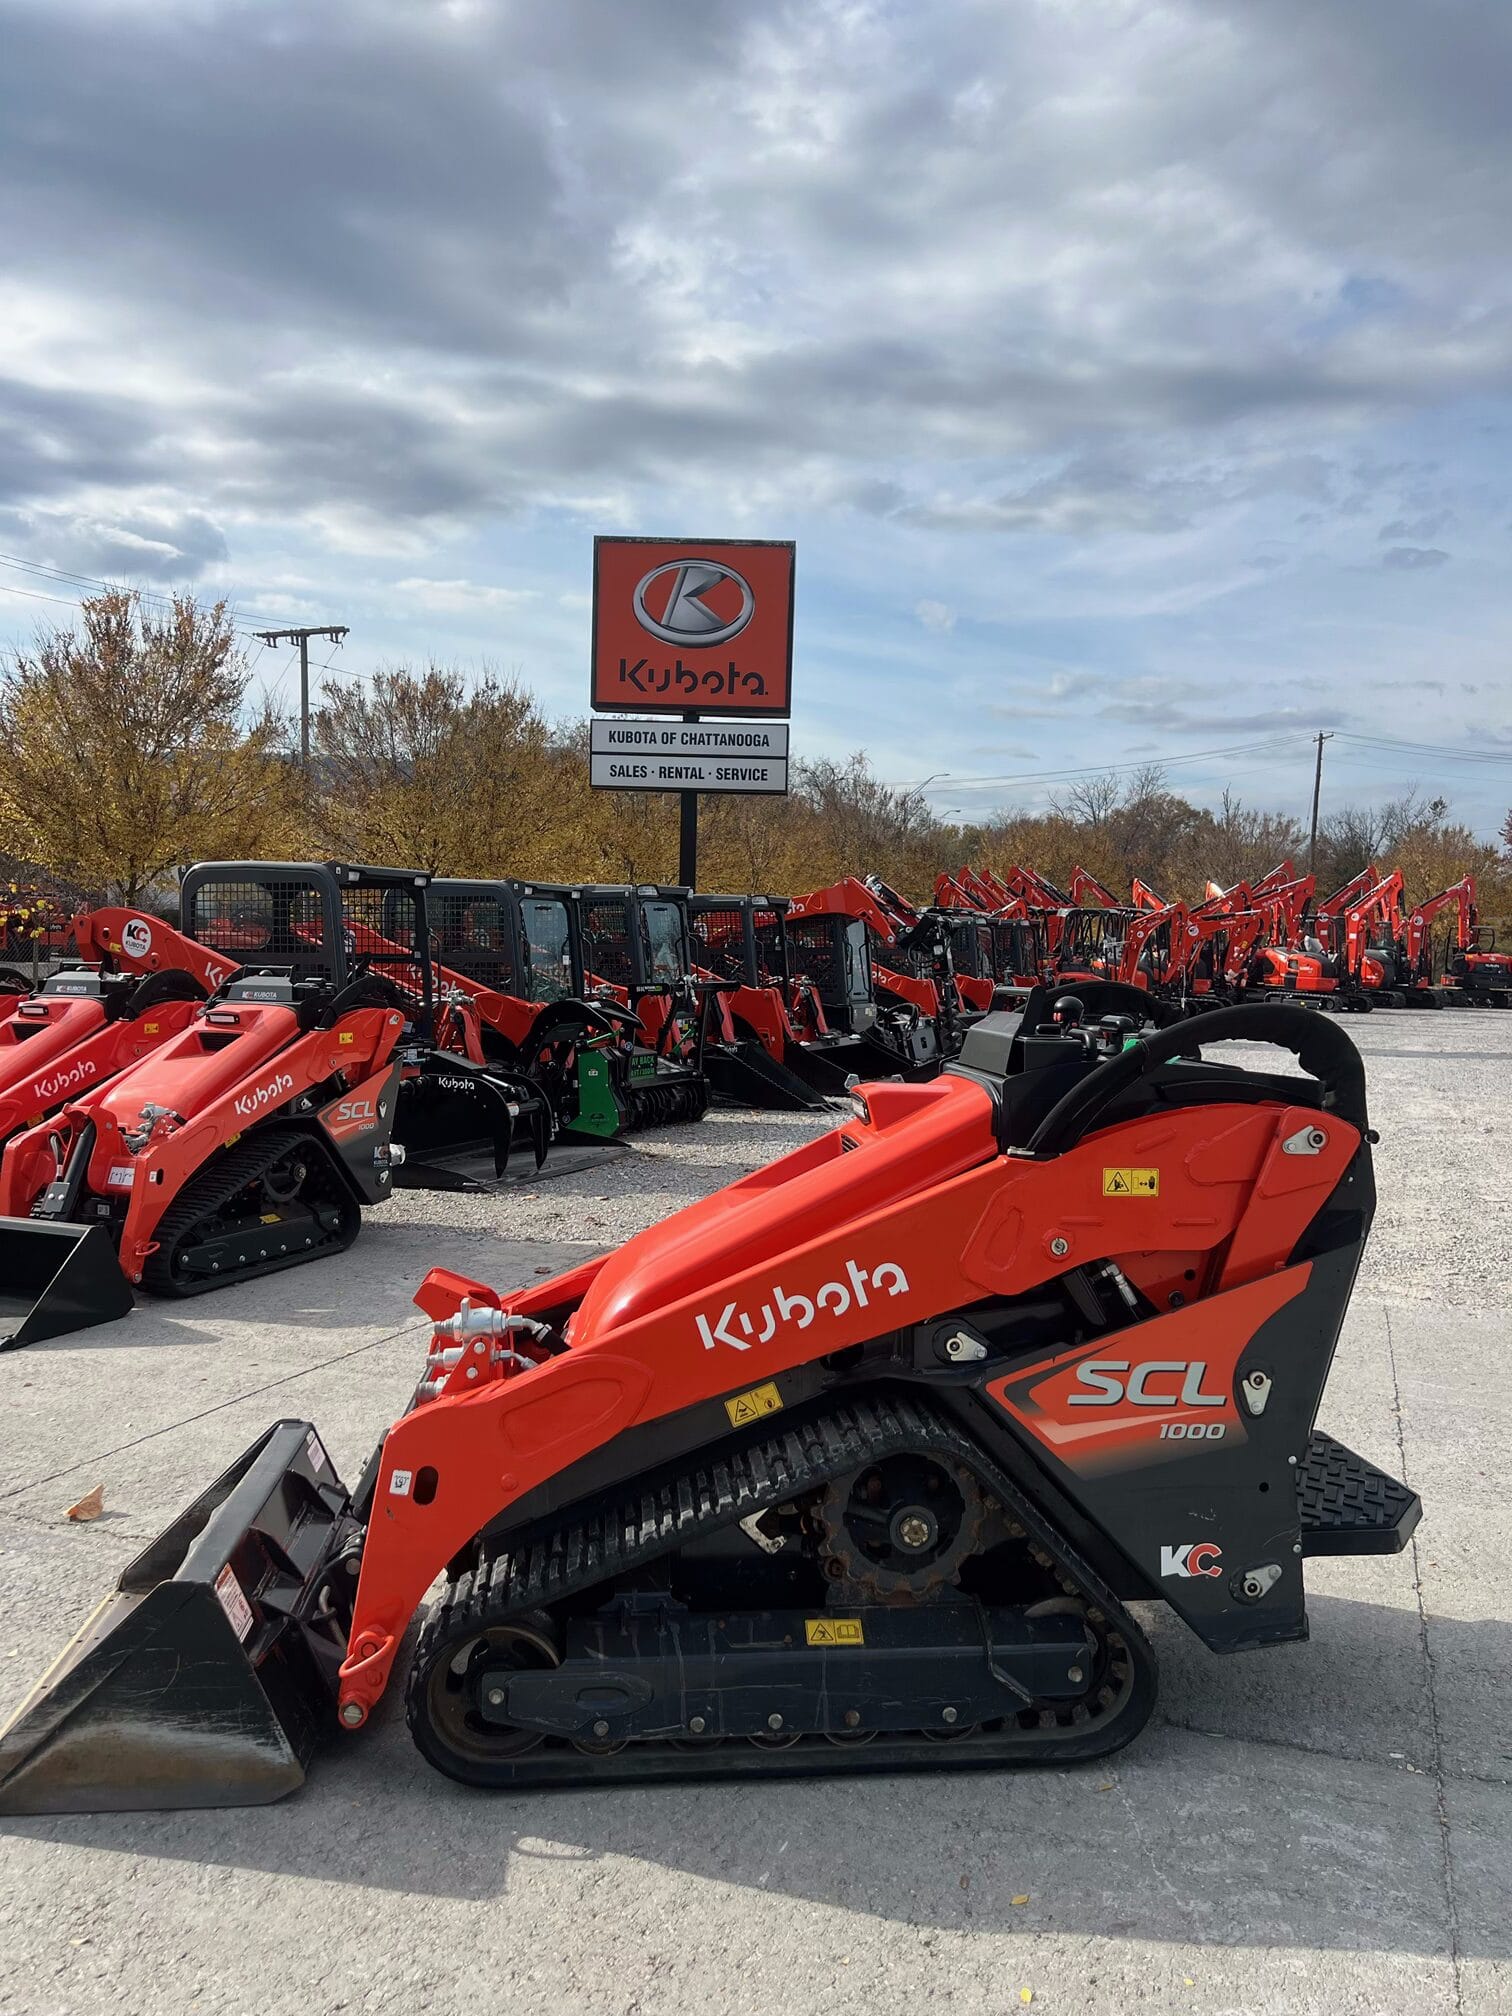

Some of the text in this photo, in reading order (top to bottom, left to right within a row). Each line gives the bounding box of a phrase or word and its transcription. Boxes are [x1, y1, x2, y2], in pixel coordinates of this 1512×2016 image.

[608, 730, 770, 748] KUBOTA OF CHATTANOOGA
[609, 764, 768, 782] SALES RENTAL SERVICE
[126, 923, 148, 943] KC
[125, 940, 147, 952] KUBOTA
[253, 991, 277, 999] KUBOTA
[34, 1059, 96, 1098] Kubota
[438, 1076, 475, 1091] Kubota
[234, 1073, 294, 1116] Kubota
[336, 1101, 375, 1121] SCL
[358, 1122, 375, 1131] 1000
[694, 1259, 910, 1352] Kubota
[1067, 1360, 1228, 1406] SCL
[1159, 1423, 1227, 1440] 1000
[1160, 1542, 1223, 1578] KC
